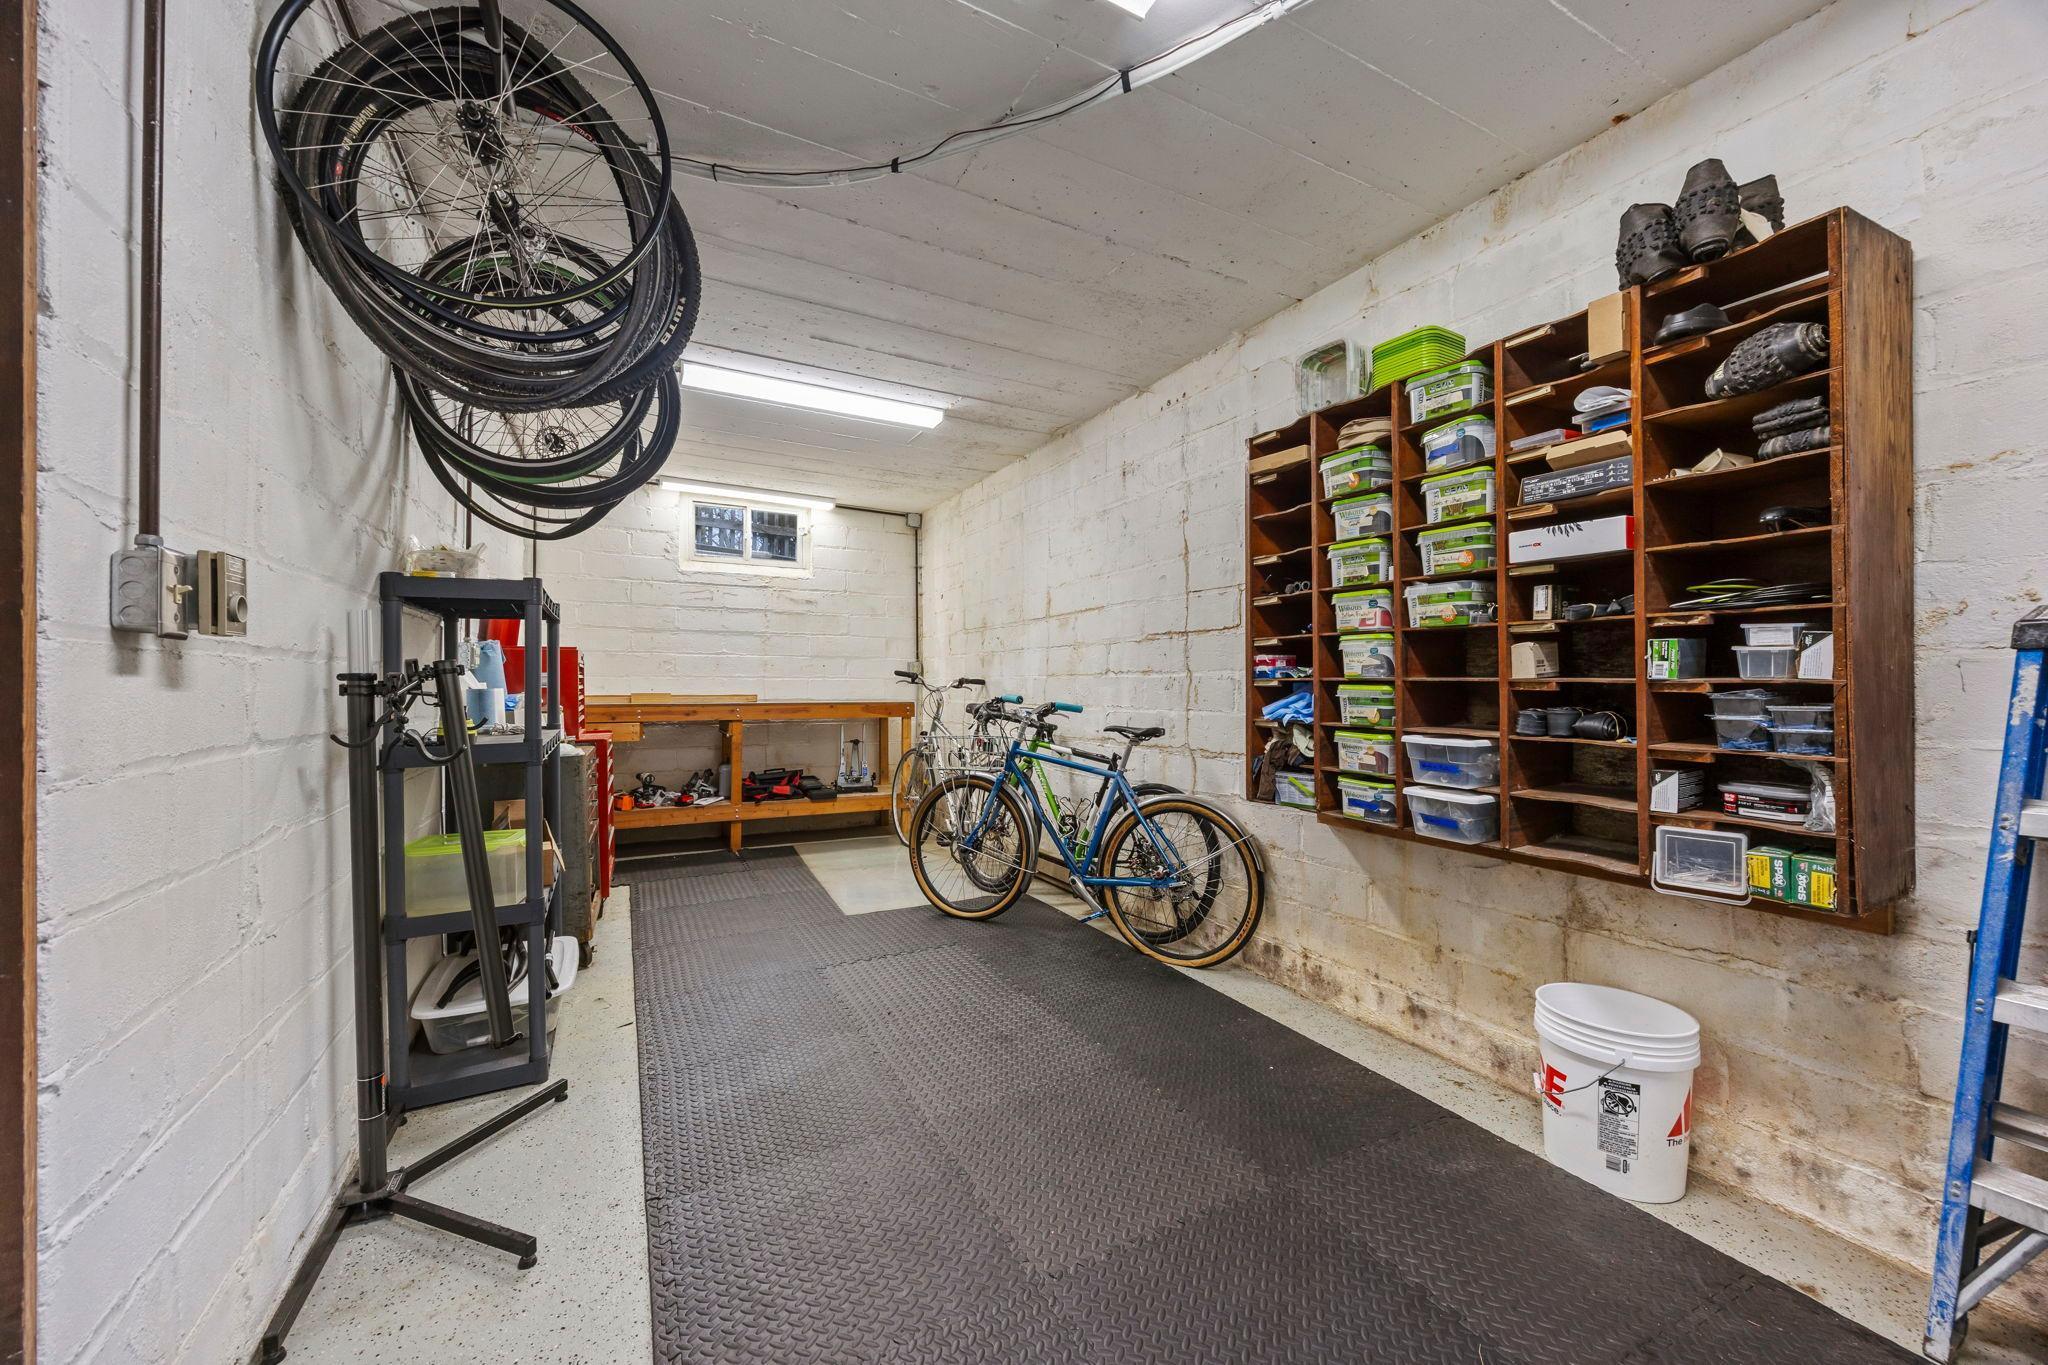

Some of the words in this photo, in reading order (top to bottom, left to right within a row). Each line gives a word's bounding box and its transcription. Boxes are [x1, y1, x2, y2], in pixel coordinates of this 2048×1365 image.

[660, 304, 684, 345] WTB
[1773, 859, 1786, 887] SPAX
[1796, 873, 1809, 901] SPAX
[1666, 1138, 1683, 1147] The
